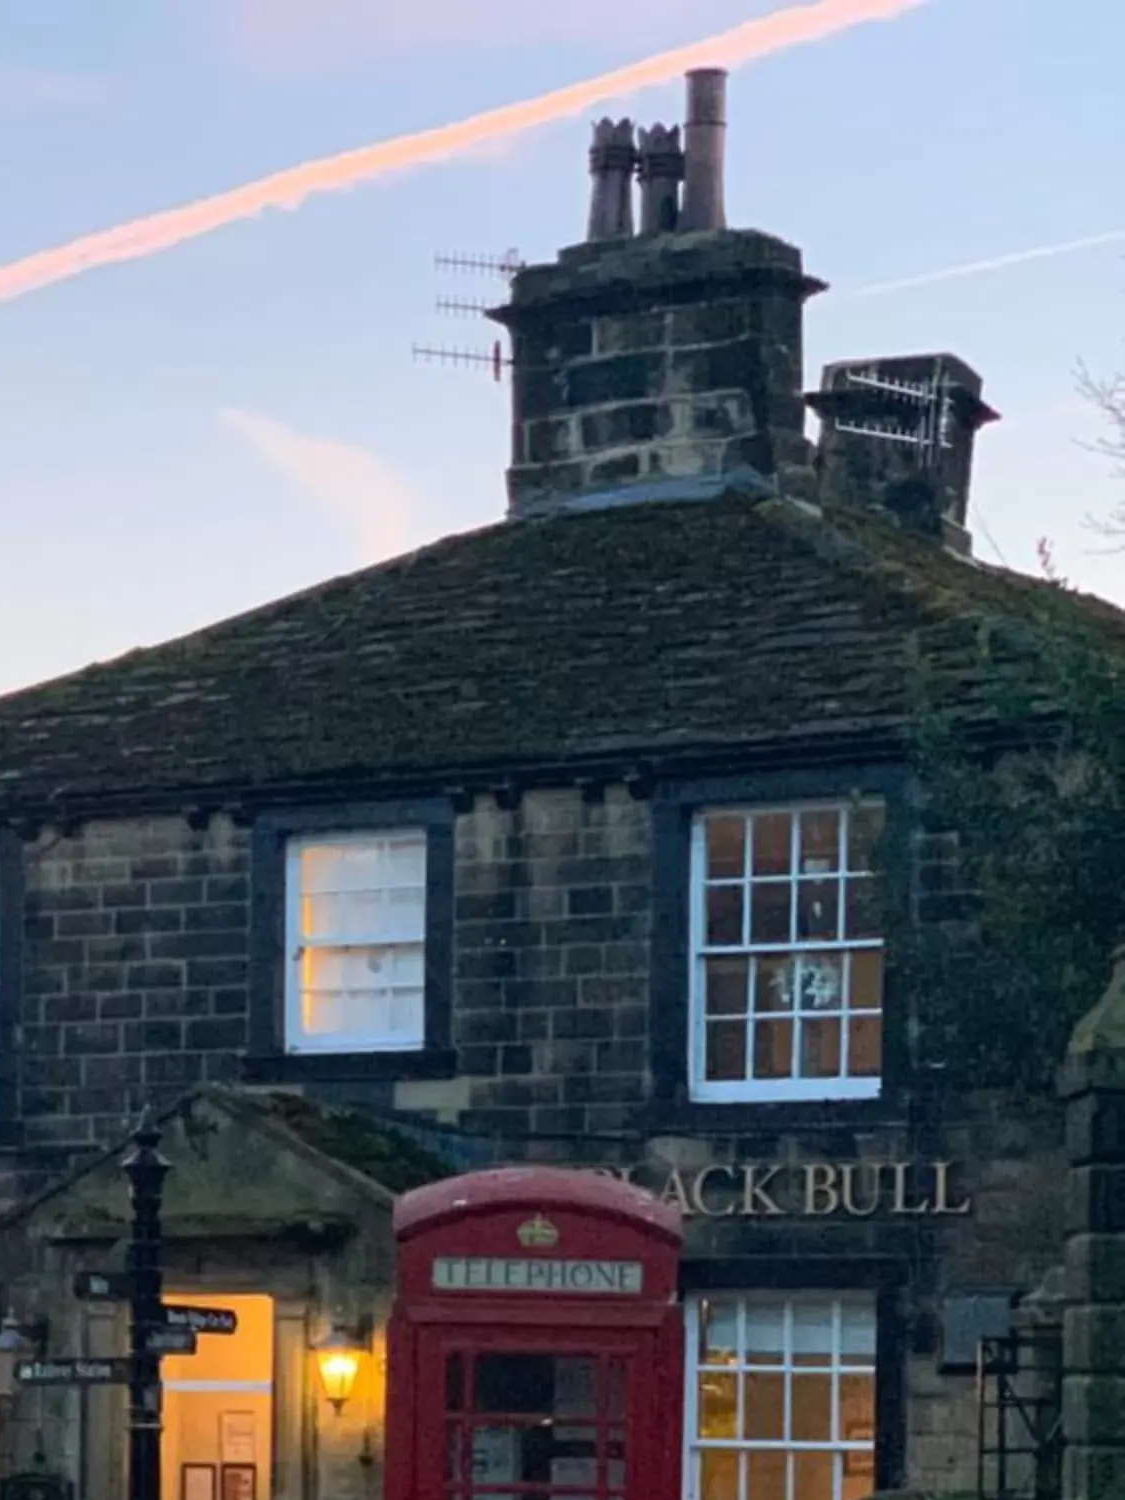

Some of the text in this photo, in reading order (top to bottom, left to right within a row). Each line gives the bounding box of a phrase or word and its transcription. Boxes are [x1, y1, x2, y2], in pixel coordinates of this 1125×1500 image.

[595, 1160, 973, 1217] ACK BULL
[442, 1258, 637, 1291] TELEPHONE
